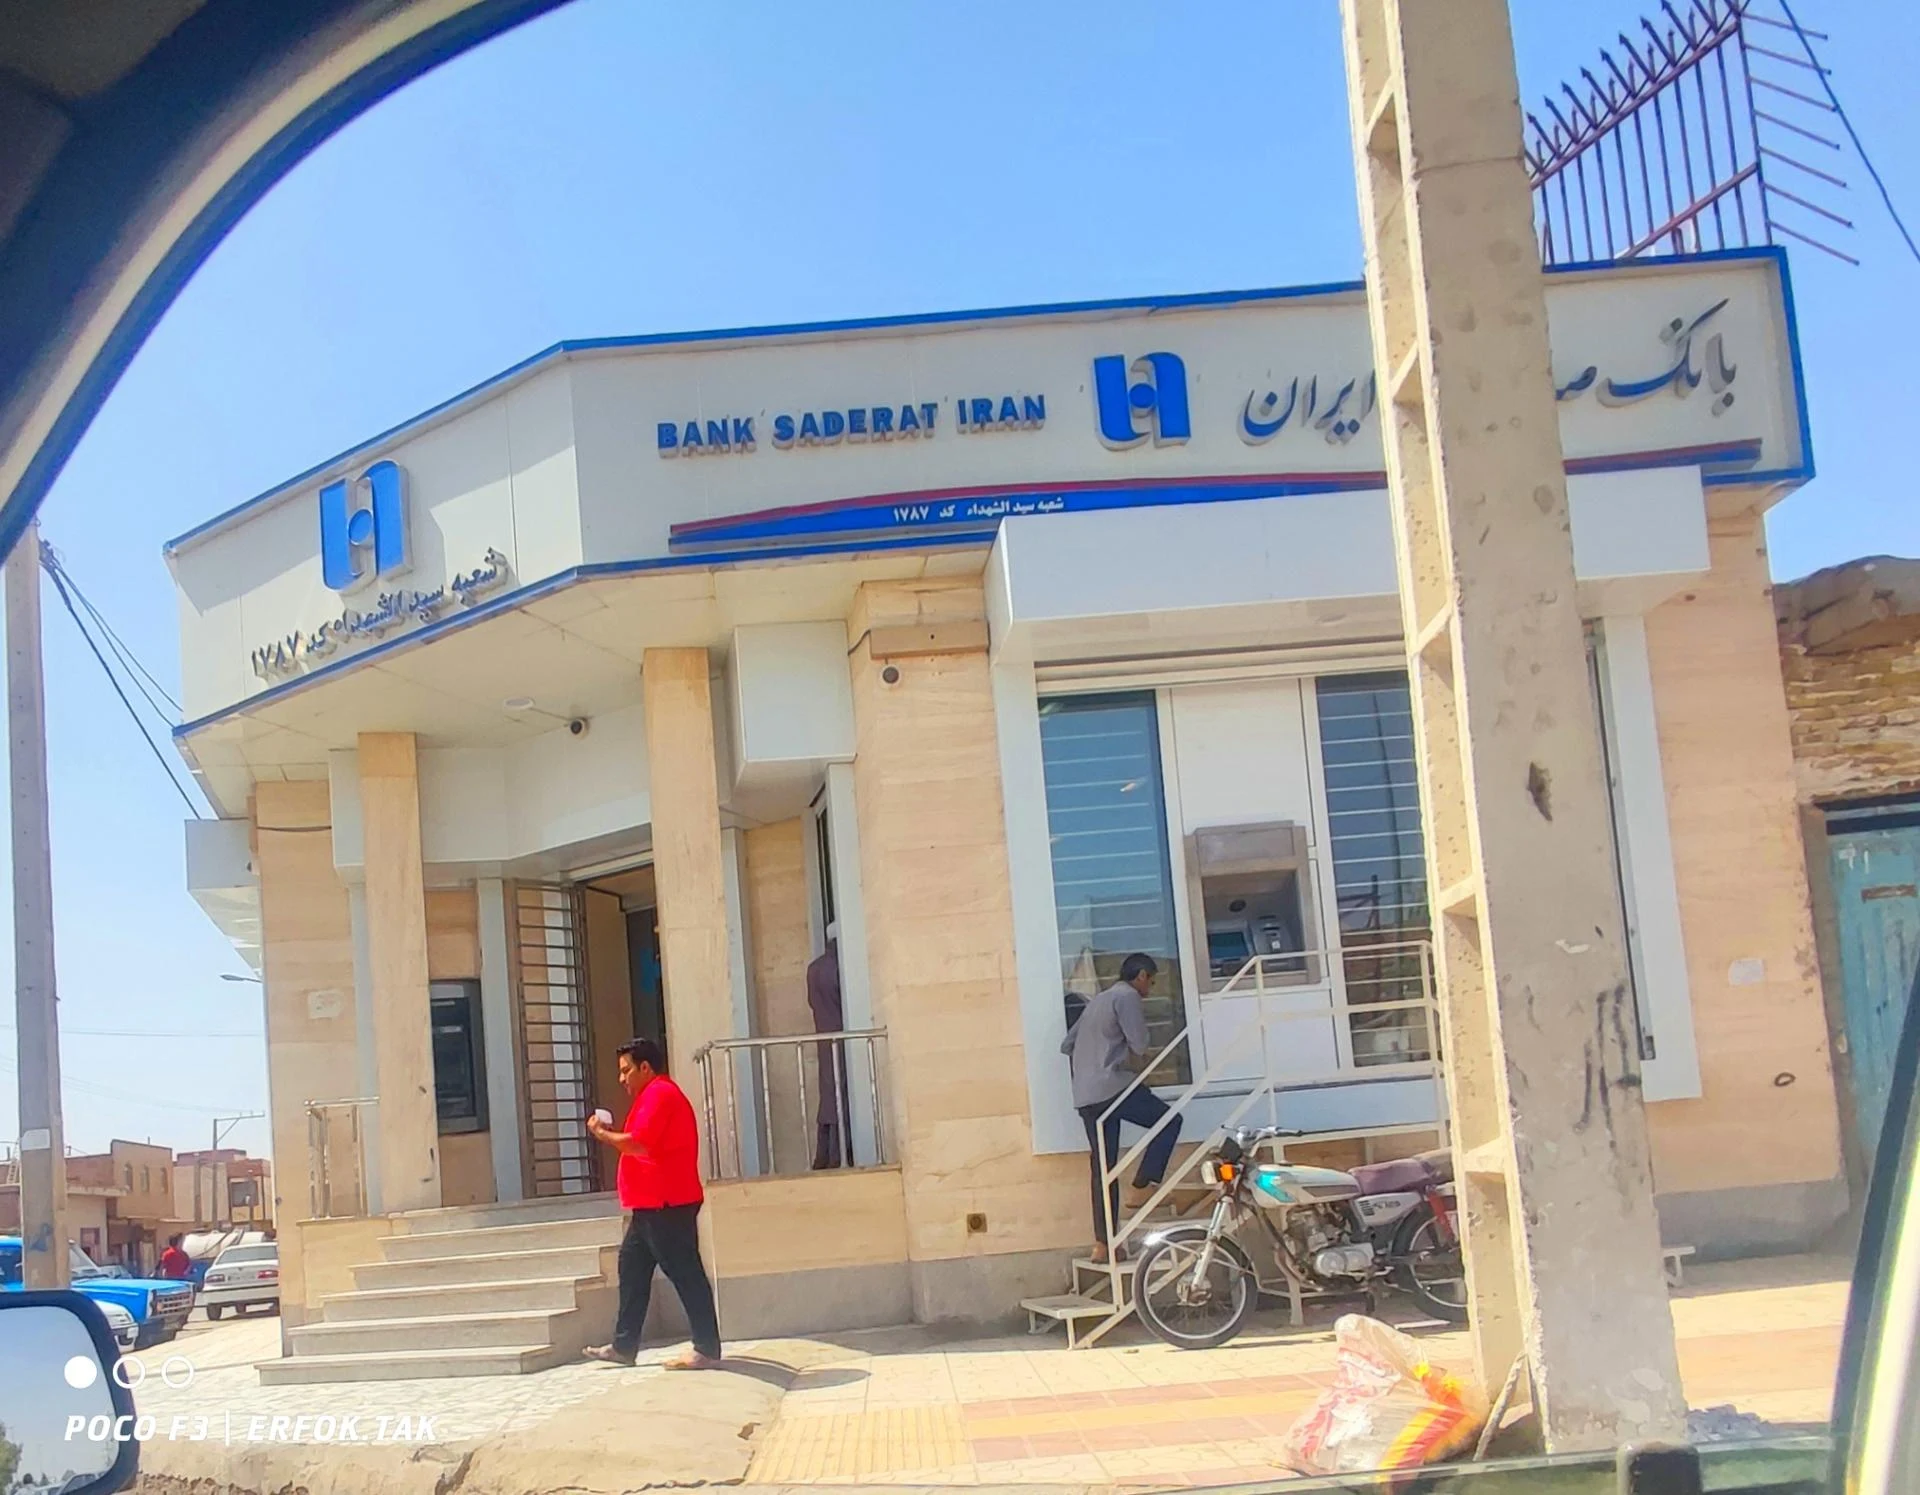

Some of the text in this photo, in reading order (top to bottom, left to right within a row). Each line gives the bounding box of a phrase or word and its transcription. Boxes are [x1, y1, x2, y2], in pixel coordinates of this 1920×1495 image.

[1243, 298, 1737, 438] بانک ایران
[657, 393, 1047, 452] BANK SADERAT IRAN
[939, 504, 956, 518] کد
[1037, 497, 1065, 510] شعبه
[451, 546, 498, 604] شعبه
